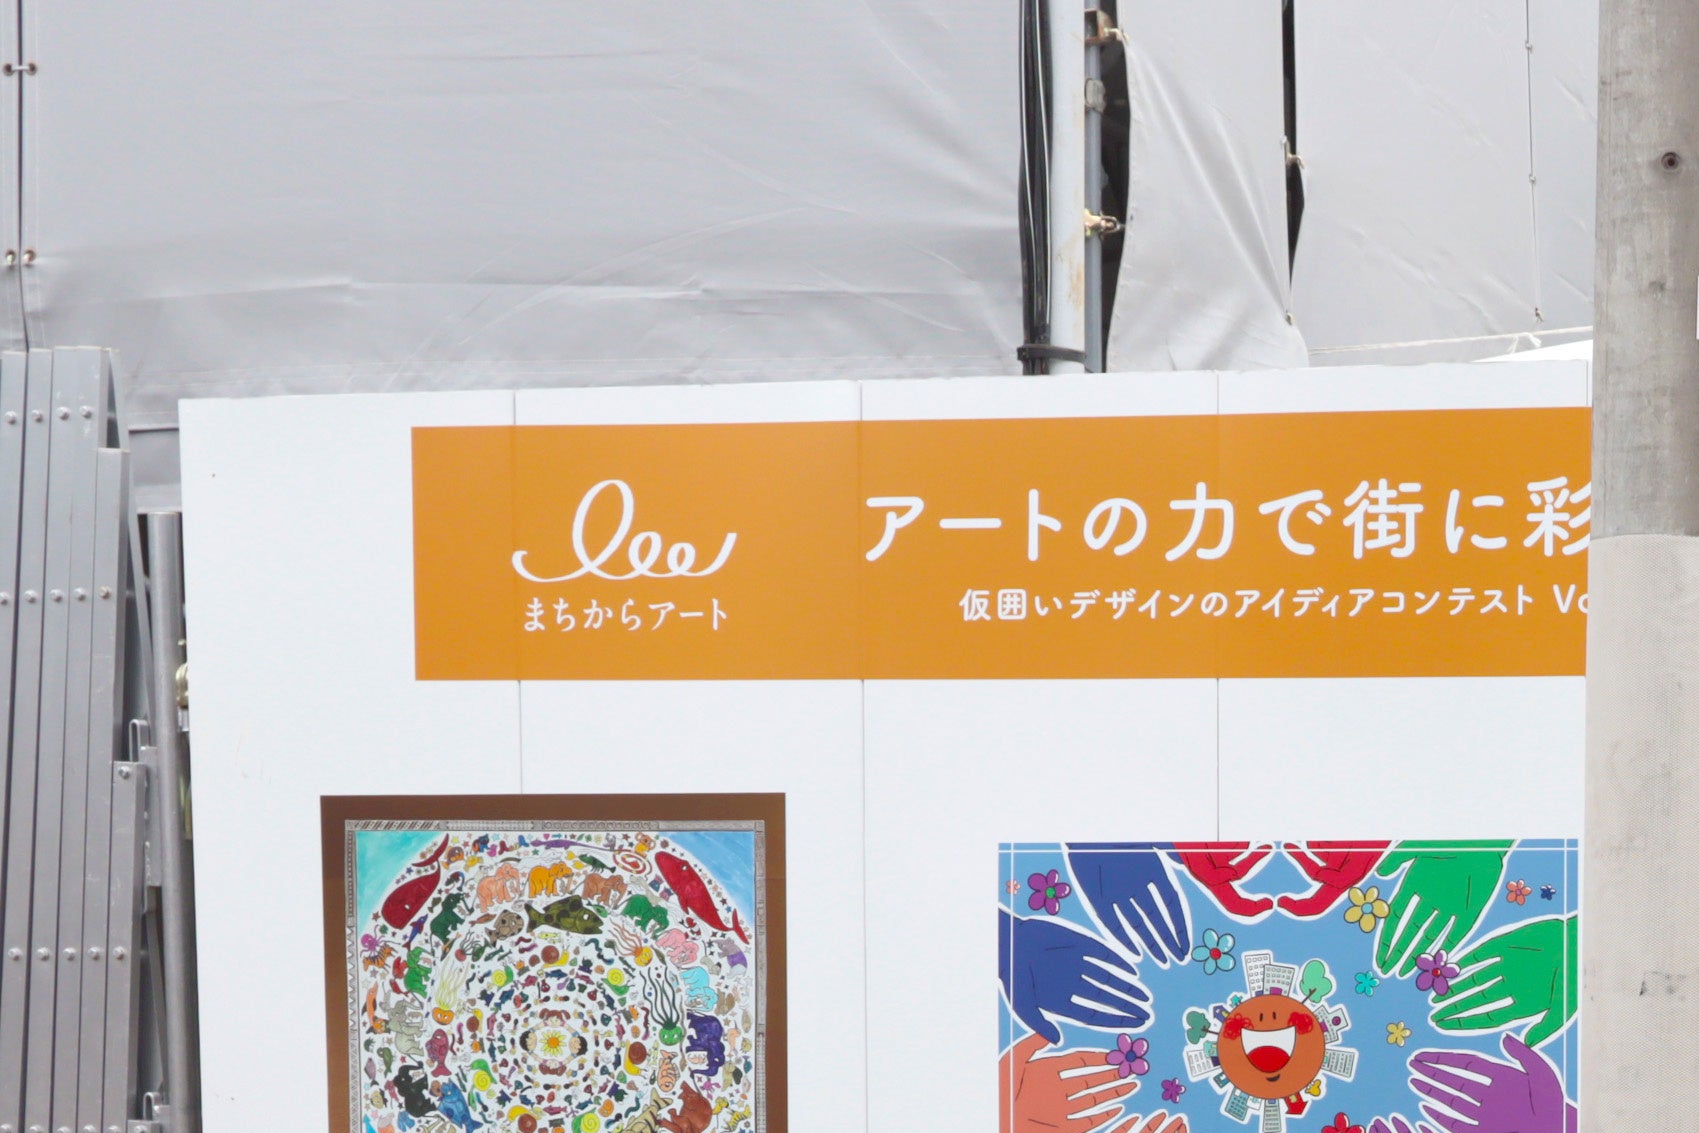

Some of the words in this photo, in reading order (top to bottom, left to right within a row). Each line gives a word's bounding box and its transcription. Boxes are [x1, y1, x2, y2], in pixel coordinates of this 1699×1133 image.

[865, 475, 1591, 562] アートの力で街に彩
[524, 597, 728, 632] まちからアート
[958, 584, 1533, 622] 仮囲いデザインのアイディアコンテスト
